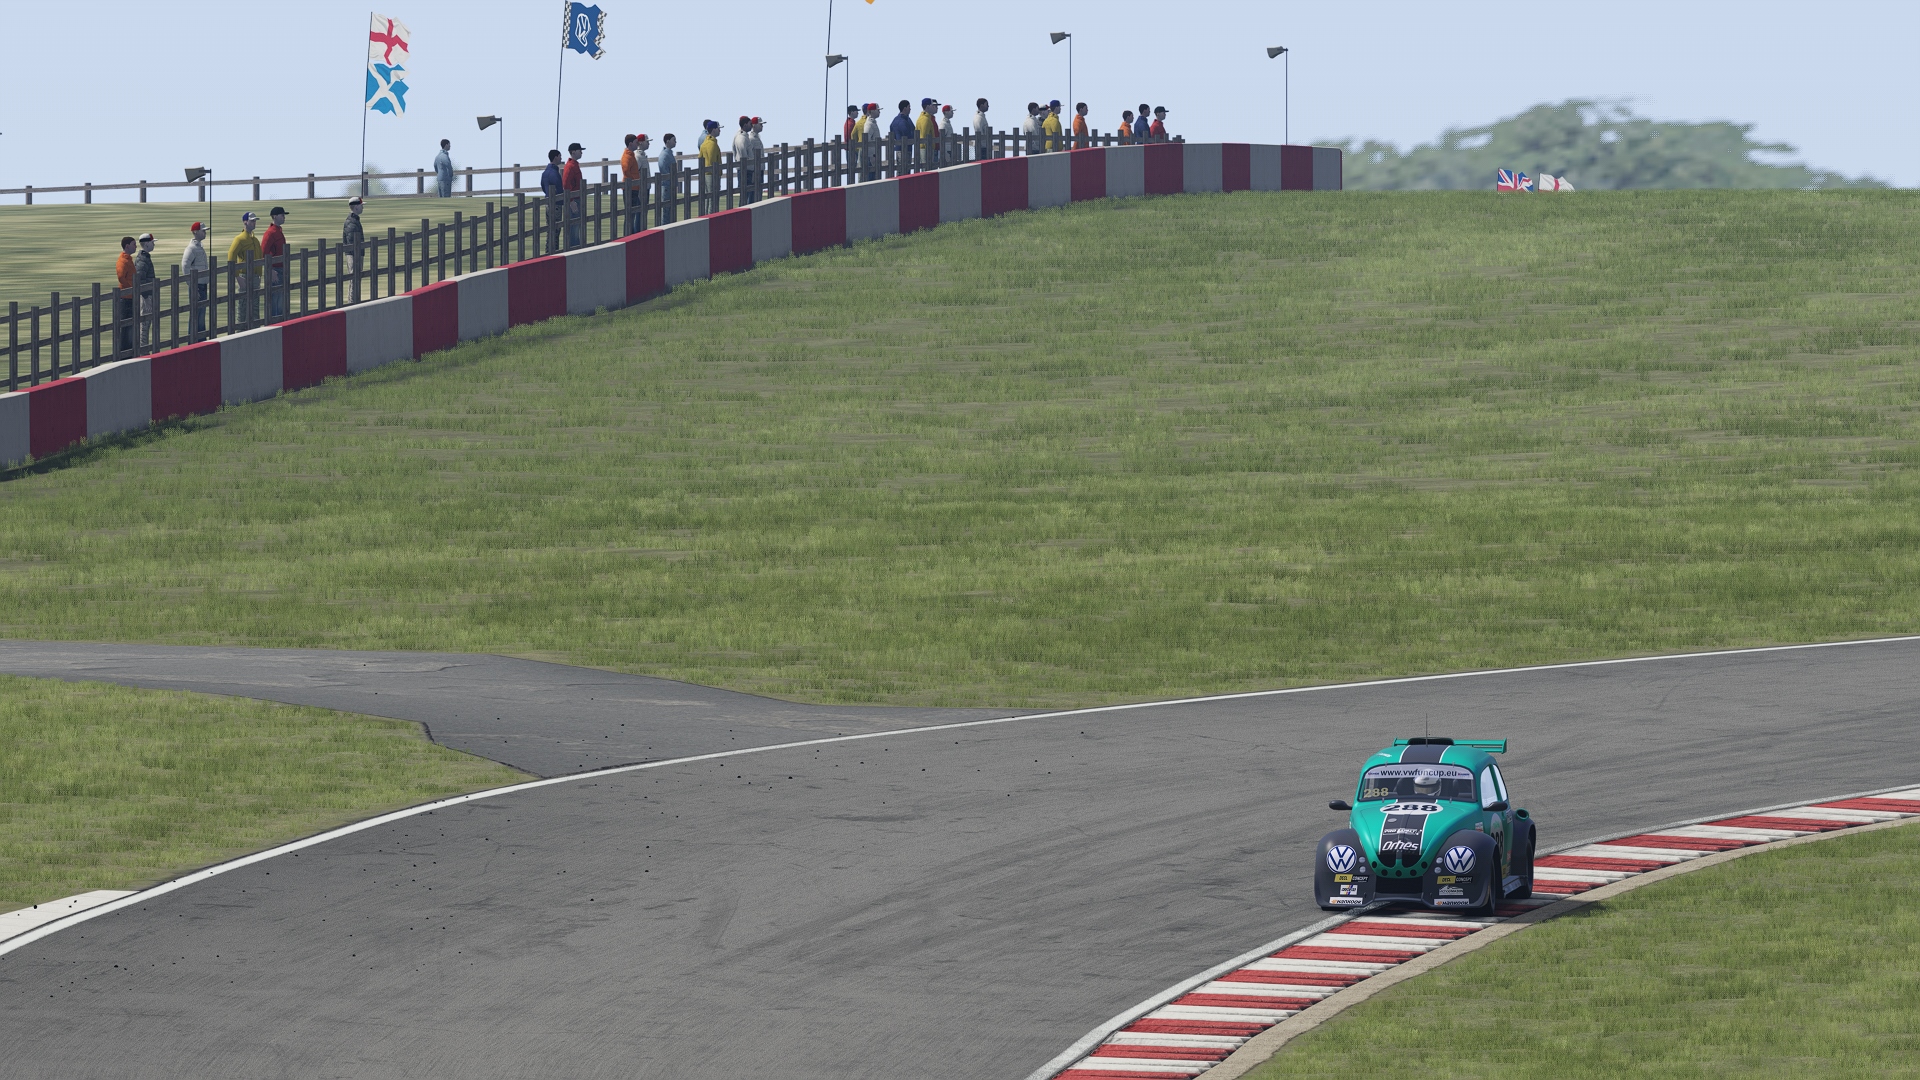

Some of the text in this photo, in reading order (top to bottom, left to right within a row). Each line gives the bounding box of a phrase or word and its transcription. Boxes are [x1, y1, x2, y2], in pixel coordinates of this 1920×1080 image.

[1380, 769, 1457, 777] www.vwfuncup.eu
[1363, 787, 1389, 798] 288
[1383, 804, 1438, 812] 288
[1327, 845, 1356, 873] VW
[1445, 846, 1476, 874] VW
